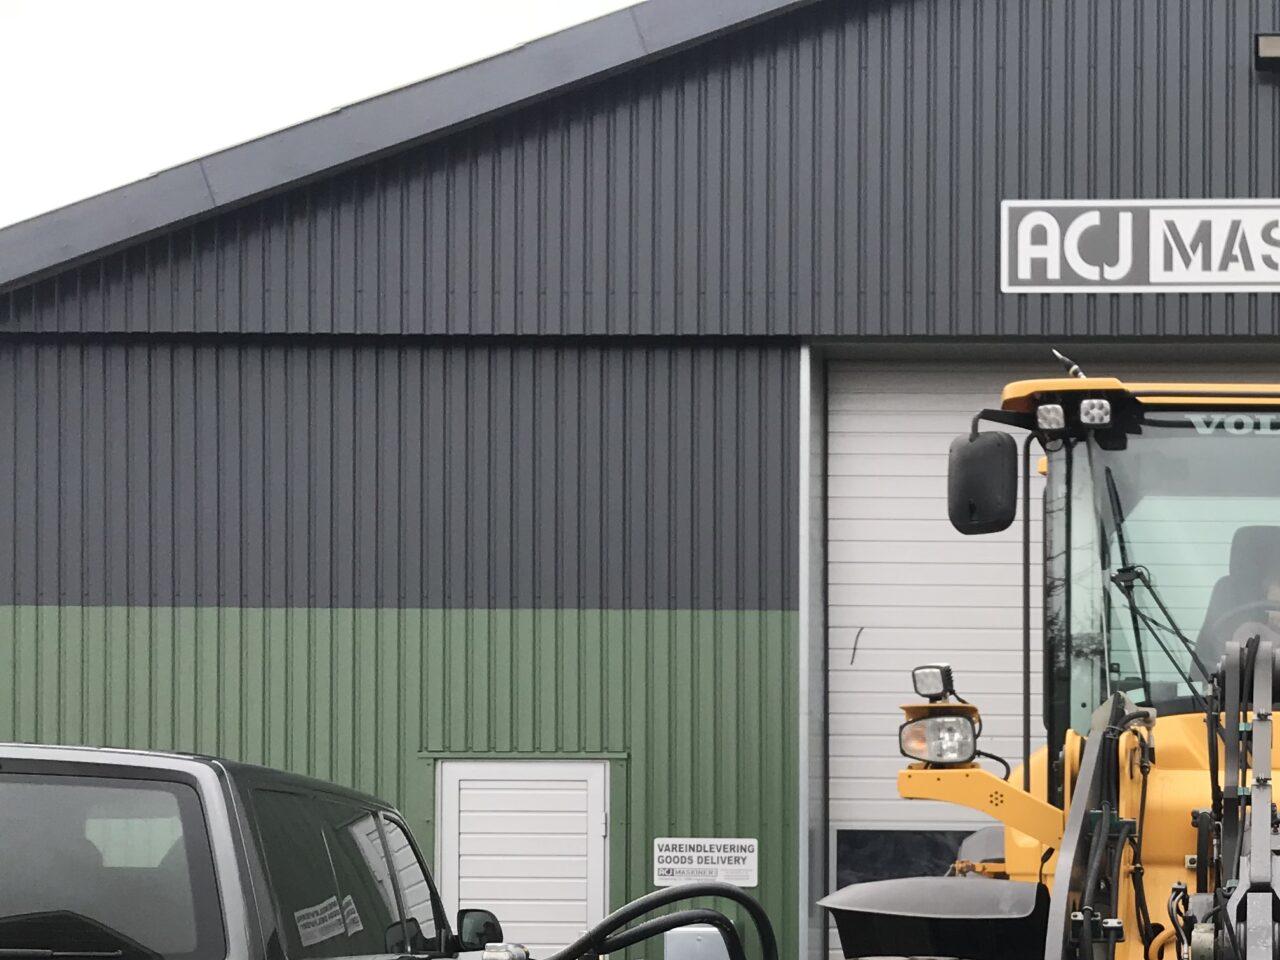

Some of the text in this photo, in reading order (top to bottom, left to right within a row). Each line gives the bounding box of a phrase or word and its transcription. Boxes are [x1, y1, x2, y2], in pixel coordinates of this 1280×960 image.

[1017, 210, 1133, 281] ACJ
[657, 844, 755, 853] VAREINDLEVERING
[657, 855, 747, 865] GOODS DELIVERY
